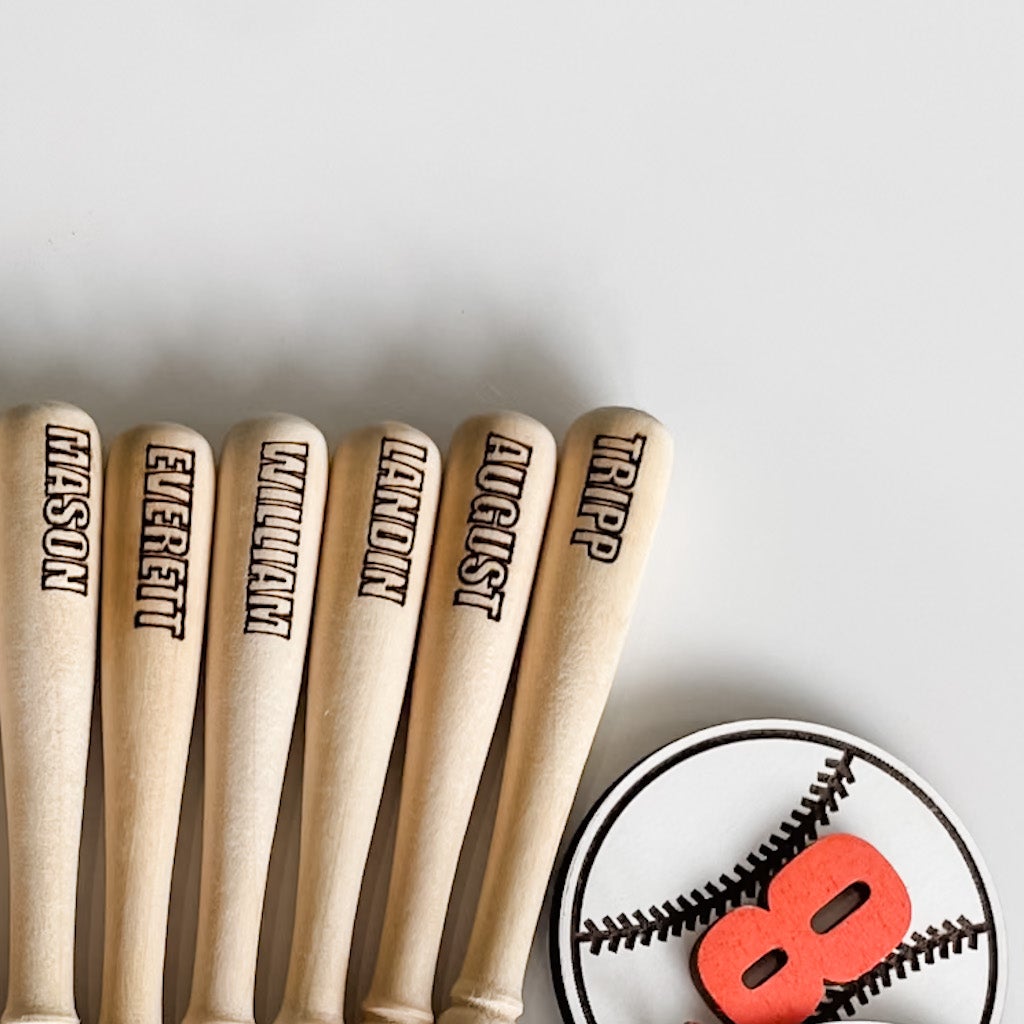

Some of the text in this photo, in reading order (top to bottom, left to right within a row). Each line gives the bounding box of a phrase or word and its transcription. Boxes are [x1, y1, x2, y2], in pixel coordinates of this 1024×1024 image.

[41, 424, 91, 596] MASON
[133, 443, 196, 641] EVERETT
[243, 441, 310, 641] WILLIAM
[357, 436, 429, 607] LANDIN
[452, 431, 534, 622] AUGUST
[570, 433, 647, 563] TRIPP
